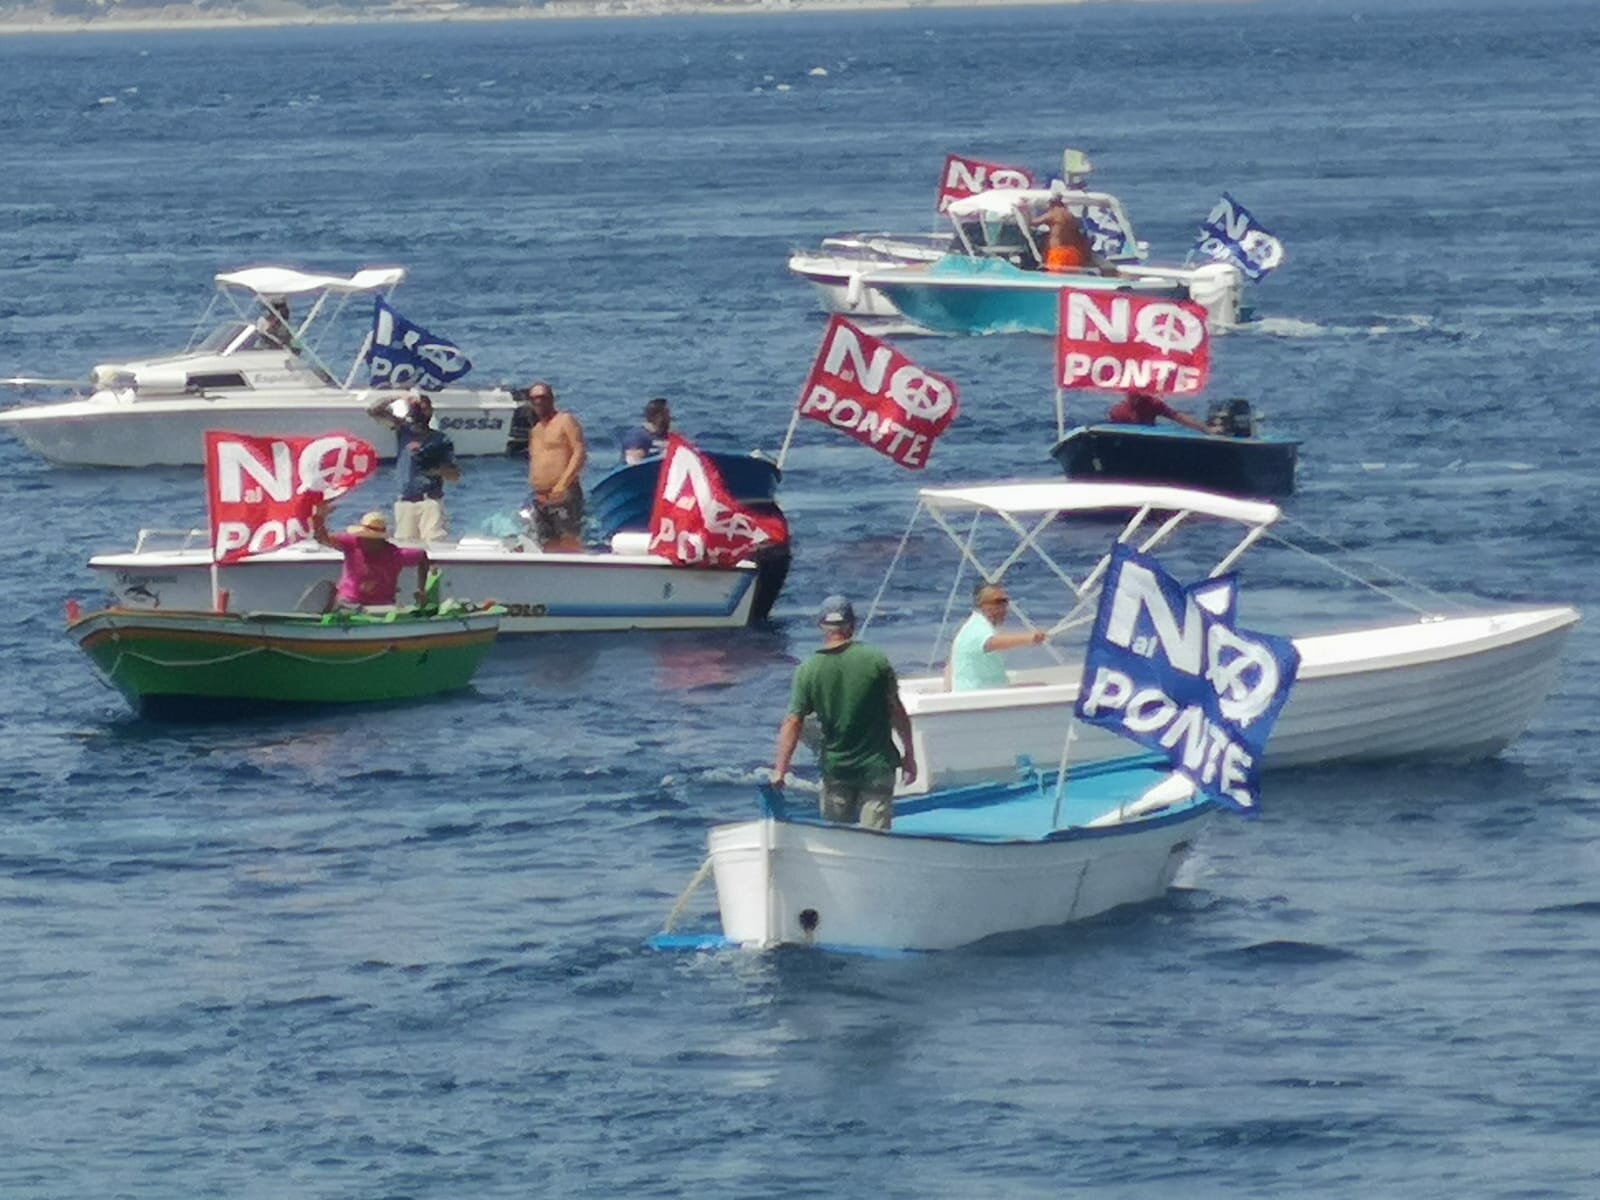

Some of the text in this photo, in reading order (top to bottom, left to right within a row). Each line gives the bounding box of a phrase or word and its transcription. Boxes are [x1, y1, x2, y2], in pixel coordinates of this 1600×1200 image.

[1206, 198, 1284, 270] NO
[1067, 293, 1203, 355] NO
[824, 325, 953, 423] NO
[1063, 352, 1201, 392] PONTE
[800, 385, 928, 465] PONTE
[217, 436, 368, 502] NO
[1106, 561, 1279, 728] NO
[1131, 636, 1157, 658] al
[1083, 667, 1252, 807] PONTE
